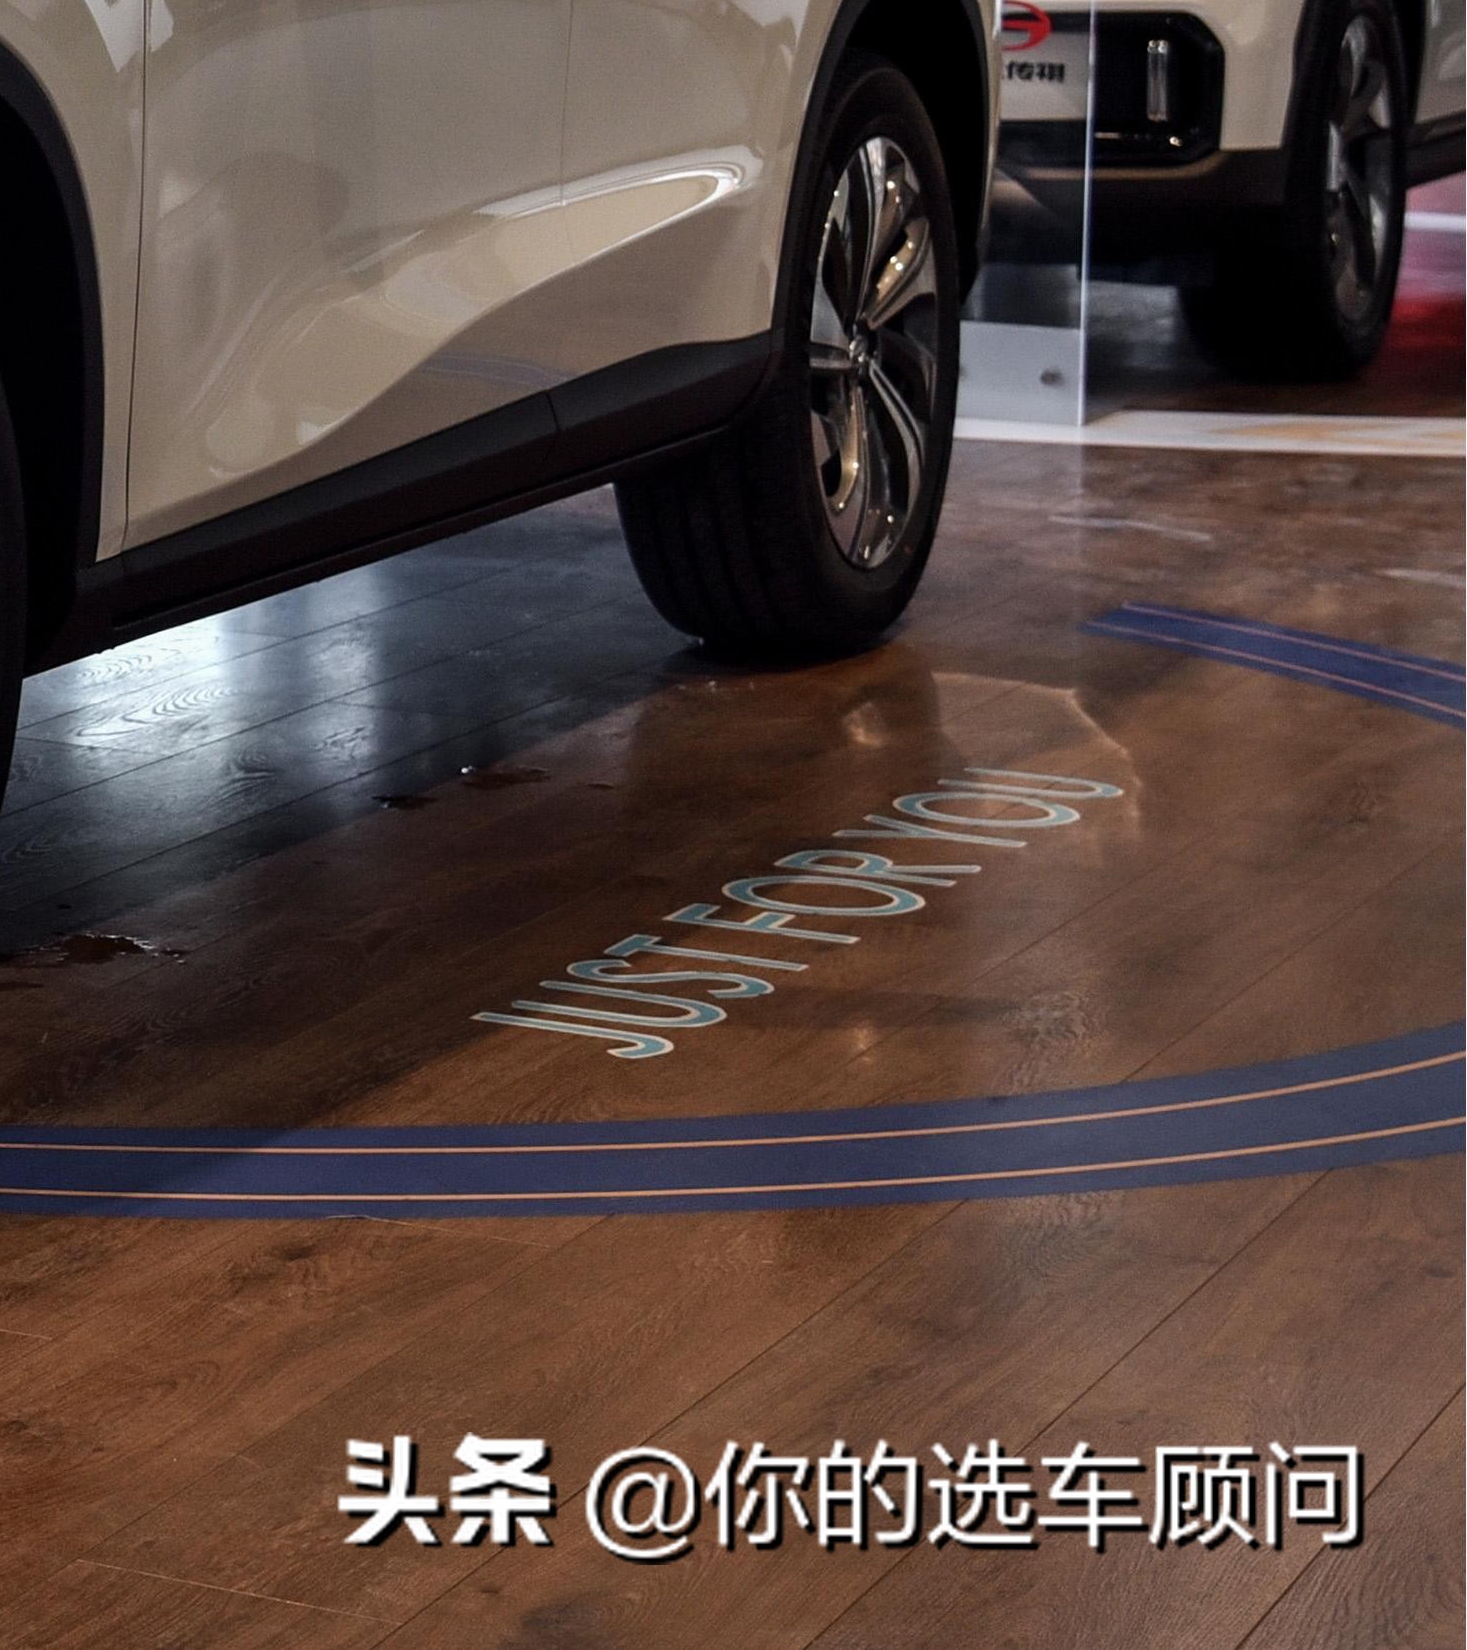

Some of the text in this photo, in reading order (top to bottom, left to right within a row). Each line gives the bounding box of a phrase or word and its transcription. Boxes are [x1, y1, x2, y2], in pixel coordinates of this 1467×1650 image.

[470, 767, 1125, 1059] JUST FOR YOU
